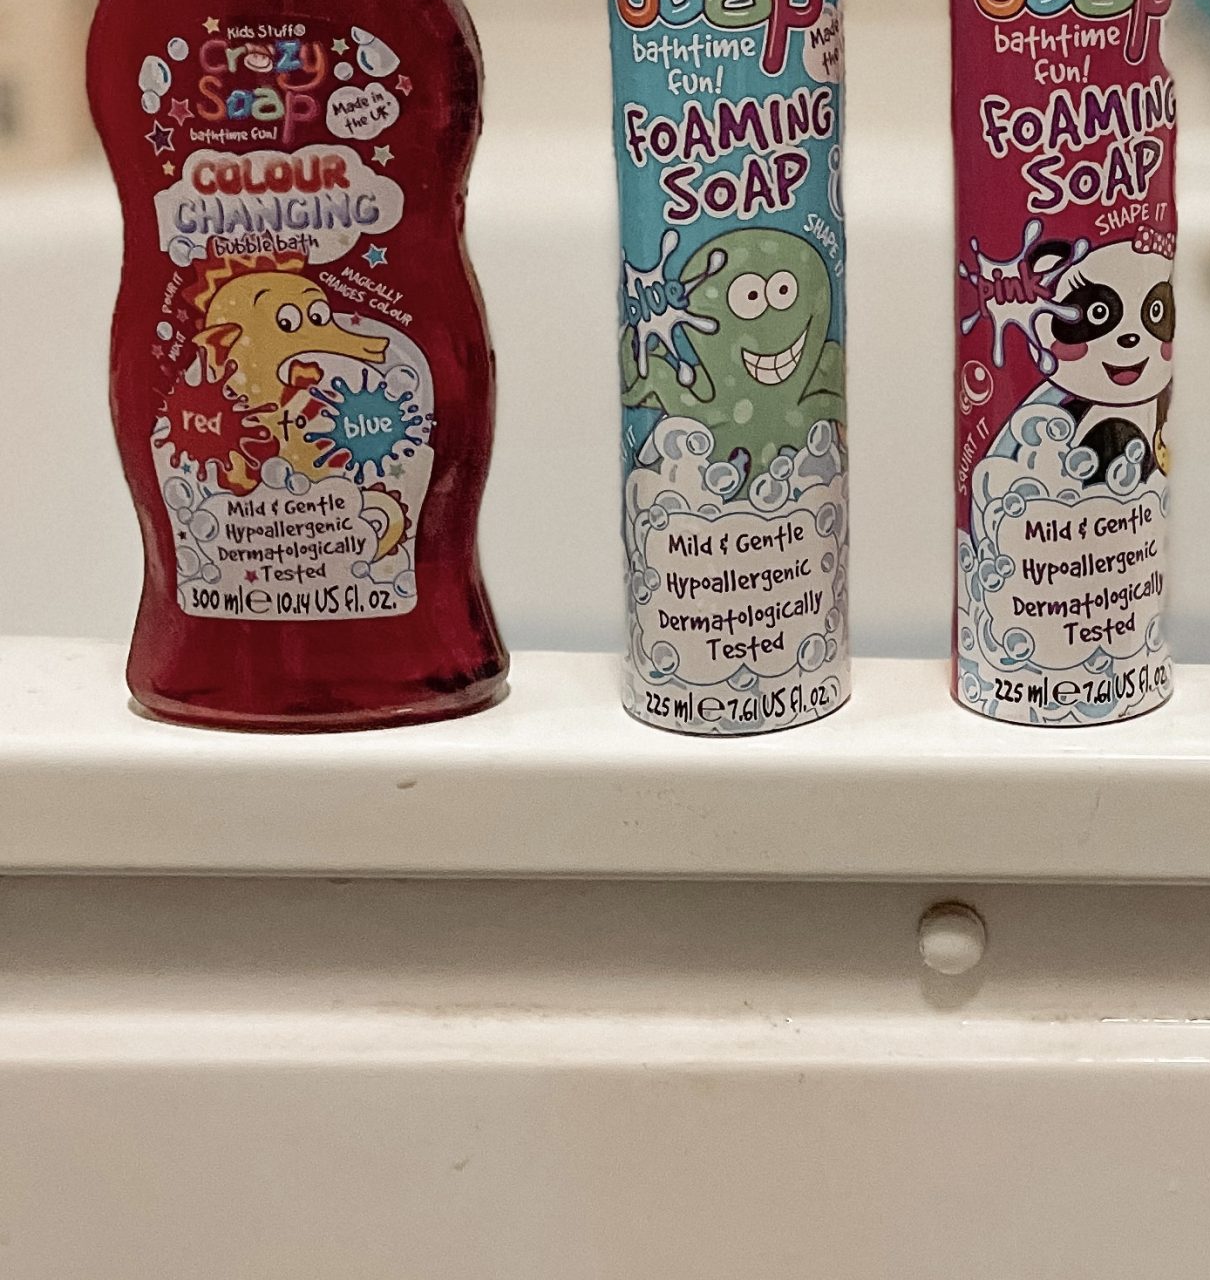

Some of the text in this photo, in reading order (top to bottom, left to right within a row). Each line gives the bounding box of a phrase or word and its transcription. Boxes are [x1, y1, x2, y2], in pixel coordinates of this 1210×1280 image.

[226, 24, 254, 39] Kids
[994, 24, 1120, 59] bathtime
[632, 32, 757, 69] bathtime
[667, 65, 724, 95] fun!
[1034, 54, 1092, 85] fun!
[196, 75, 321, 145] Soap
[331, 92, 384, 116] Made in
[982, 78, 1177, 155] FOAMING
[189, 127, 249, 144] bathtime
[344, 114, 368, 134] the
[625, 88, 833, 165] FOAMING
[191, 152, 351, 195] COLOUR
[662, 151, 809, 222] SOAP
[1024, 139, 1163, 211] SOAP
[173, 192, 381, 235] CHANGING
[1094, 202, 1169, 237] SHAPE IT
[213, 232, 320, 258] bubble bath
[803, 213, 839, 259] SHAPE
[161, 270, 184, 315] POUR IT
[318, 271, 413, 327] CHANGES COLOUR
[340, 266, 404, 305] MAGICALLY
[622, 277, 690, 327] blue
[976, 259, 1053, 319] pink
[167, 340, 184, 362] MIX
[182, 409, 223, 435] red
[277, 409, 308, 442] to
[343, 414, 394, 440] blue
[957, 416, 990, 496] SQUIRT IT
[227, 499, 266, 518] Mild
[284, 494, 346, 519] Gentle
[1024, 519, 1072, 543] Mild
[1094, 504, 1153, 536] Gentle
[224, 517, 355, 541] Hypoallergenic
[668, 533, 713, 557] Mild
[735, 522, 804, 554] Gentle
[217, 536, 367, 564] Dermatologically
[1022, 539, 1158, 584] Hypoallergenic
[260, 563, 327, 585] Tested
[666, 558, 812, 599] Hypoallergenic
[192, 587, 220, 610] 300
[224, 585, 244, 615] ml
[276, 591, 311, 615] 10.14
[314, 585, 340, 614] US
[344, 583, 364, 613] fl.
[368, 589, 397, 610] oz.
[658, 591, 823, 635] Dermatologically
[1012, 571, 1164, 618] Dermatologically
[706, 631, 785, 662] Tested
[1063, 612, 1136, 645] Tested
[645, 691, 670, 717] 225
[674, 692, 693, 723] ml
[727, 696, 758, 721] 7.61
[762, 687, 786, 718] US
[790, 684, 807, 715] fl.
[994, 678, 1023, 704] 225
[1027, 677, 1048, 708] ml
[1082, 680, 1111, 705] 7.61
[1115, 668, 1136, 699] US
